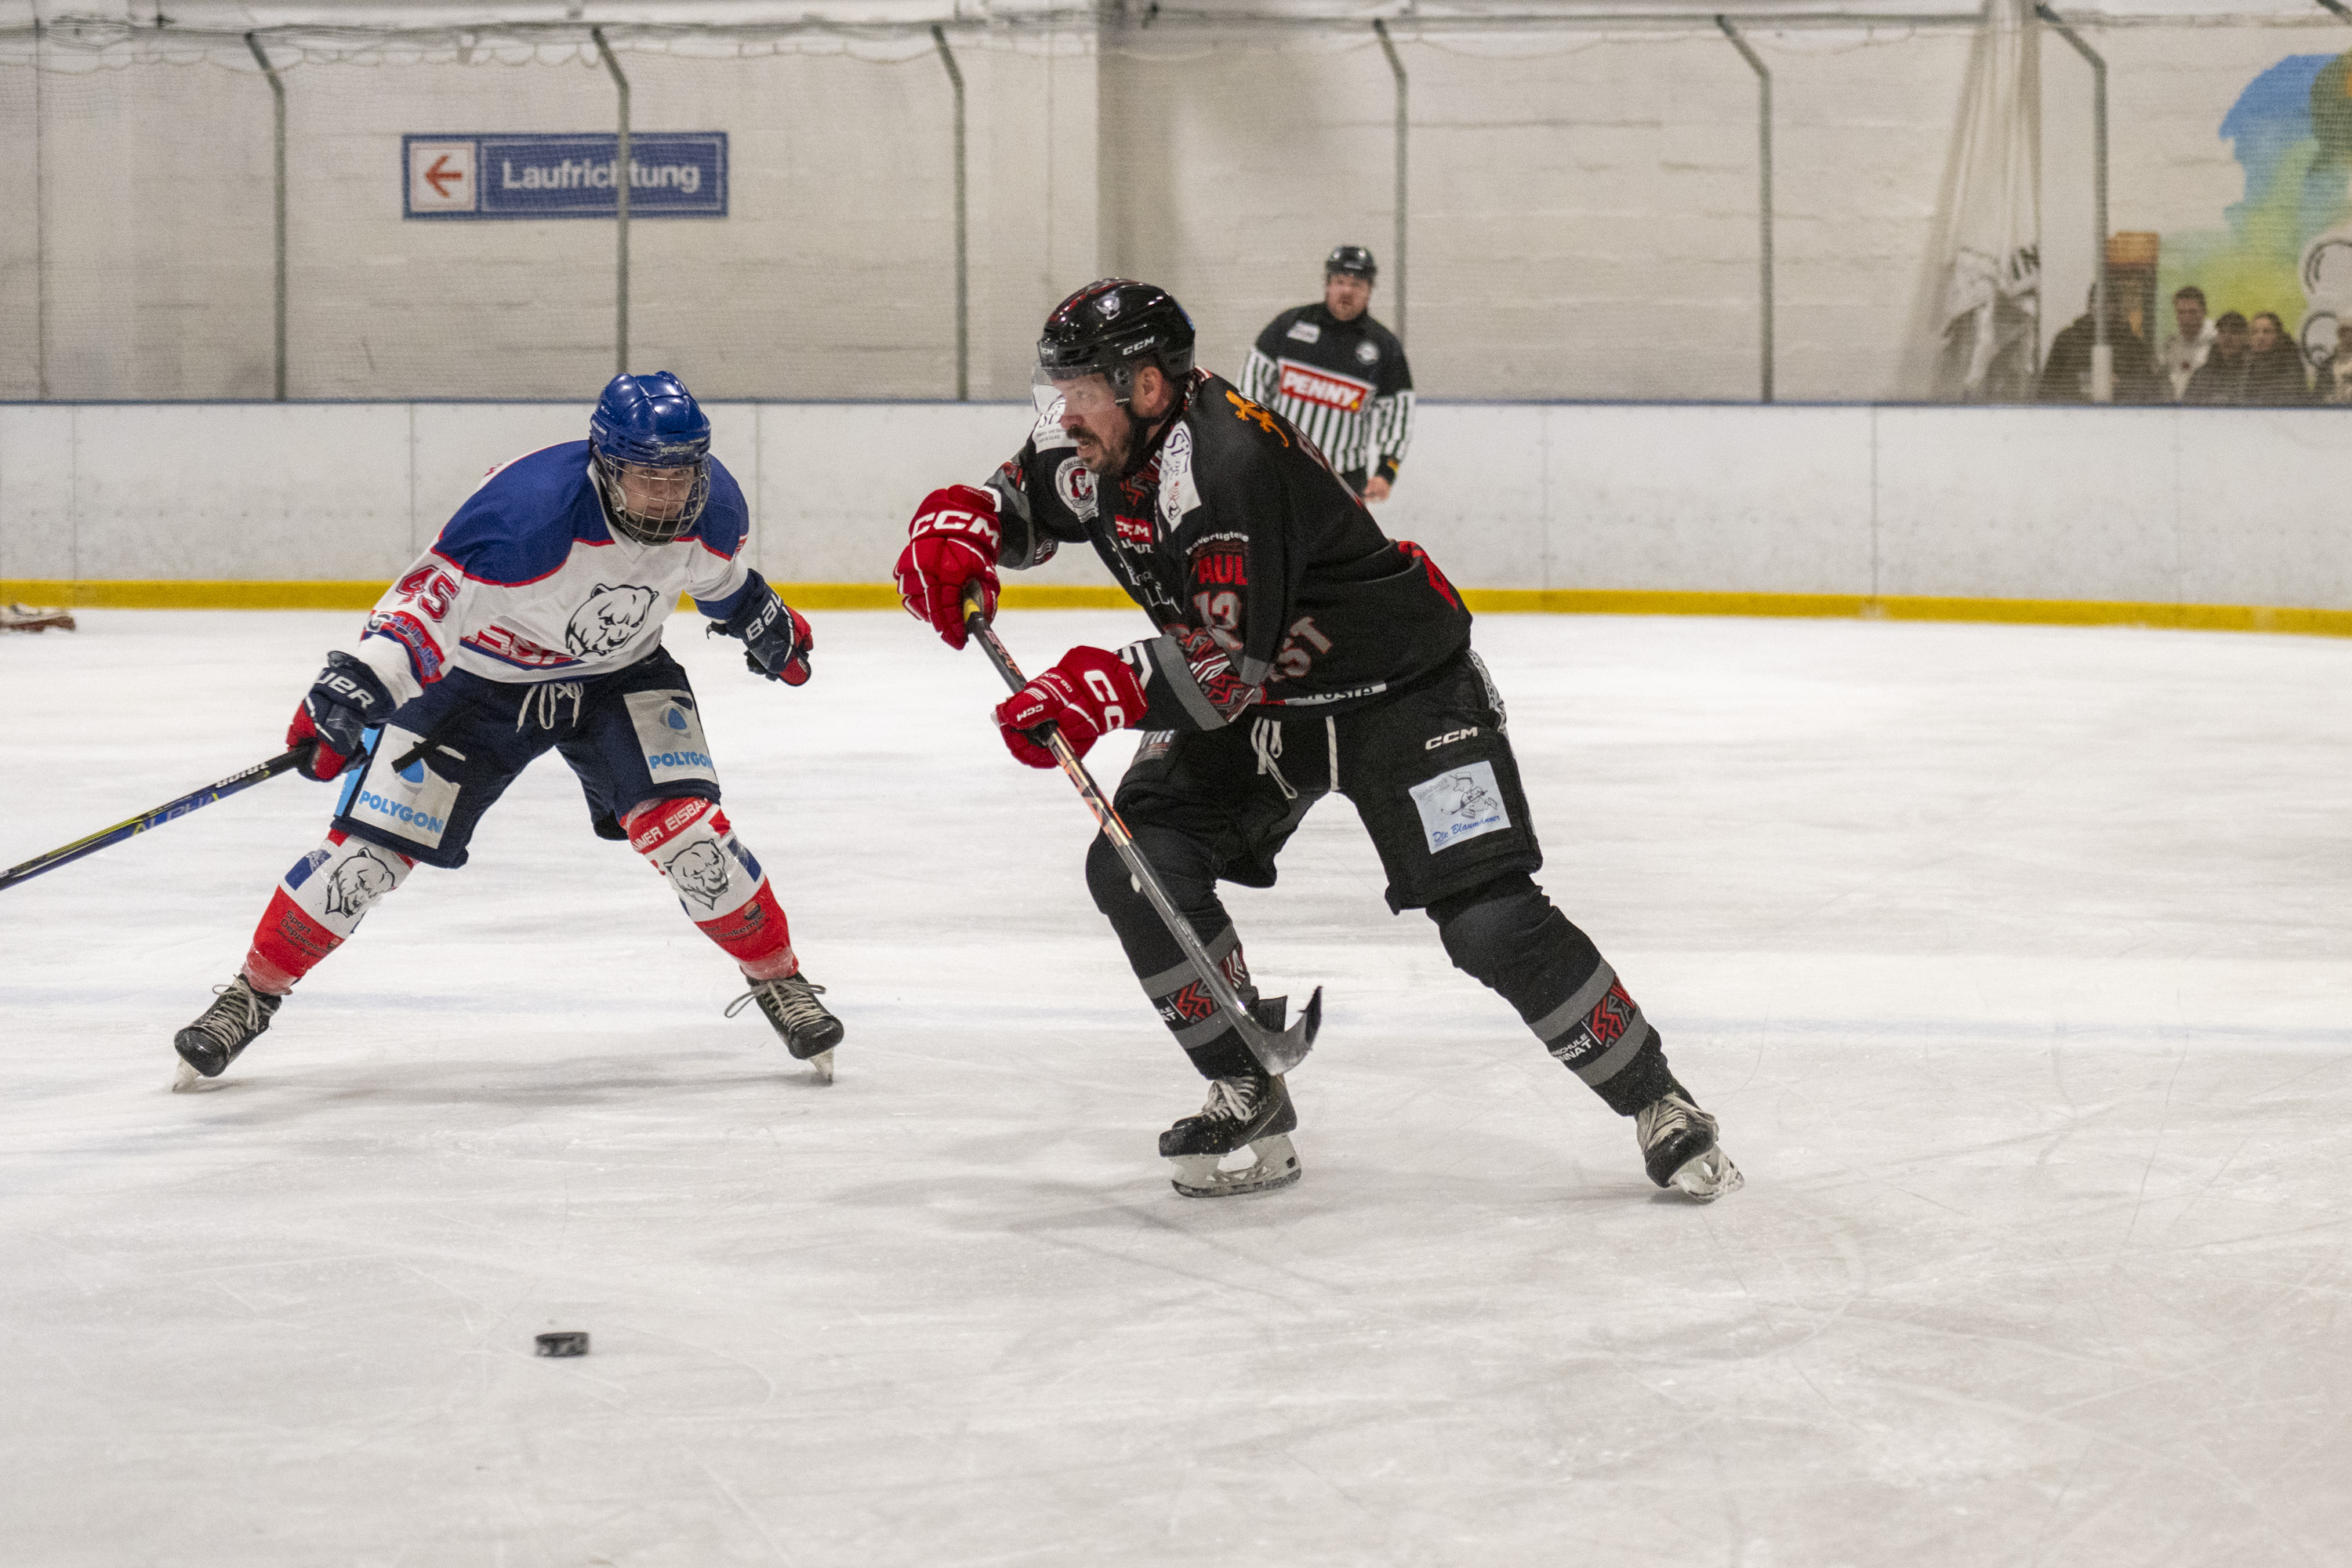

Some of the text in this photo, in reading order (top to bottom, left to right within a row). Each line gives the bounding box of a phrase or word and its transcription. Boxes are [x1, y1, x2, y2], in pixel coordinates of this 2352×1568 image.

[1122, 336, 1156, 356] CCM
[1283, 371, 1363, 407] PENNY
[911, 510, 1000, 549] CCM
[1190, 554, 1247, 585] AUL
[395, 564, 460, 623] 45
[315, 670, 376, 710] UER
[1017, 703, 1044, 723] CCM
[1425, 726, 1479, 750] CCM
[358, 789, 445, 834] POLYGON
[1432, 831, 1449, 843] Die
[285, 909, 312, 935] Sport
